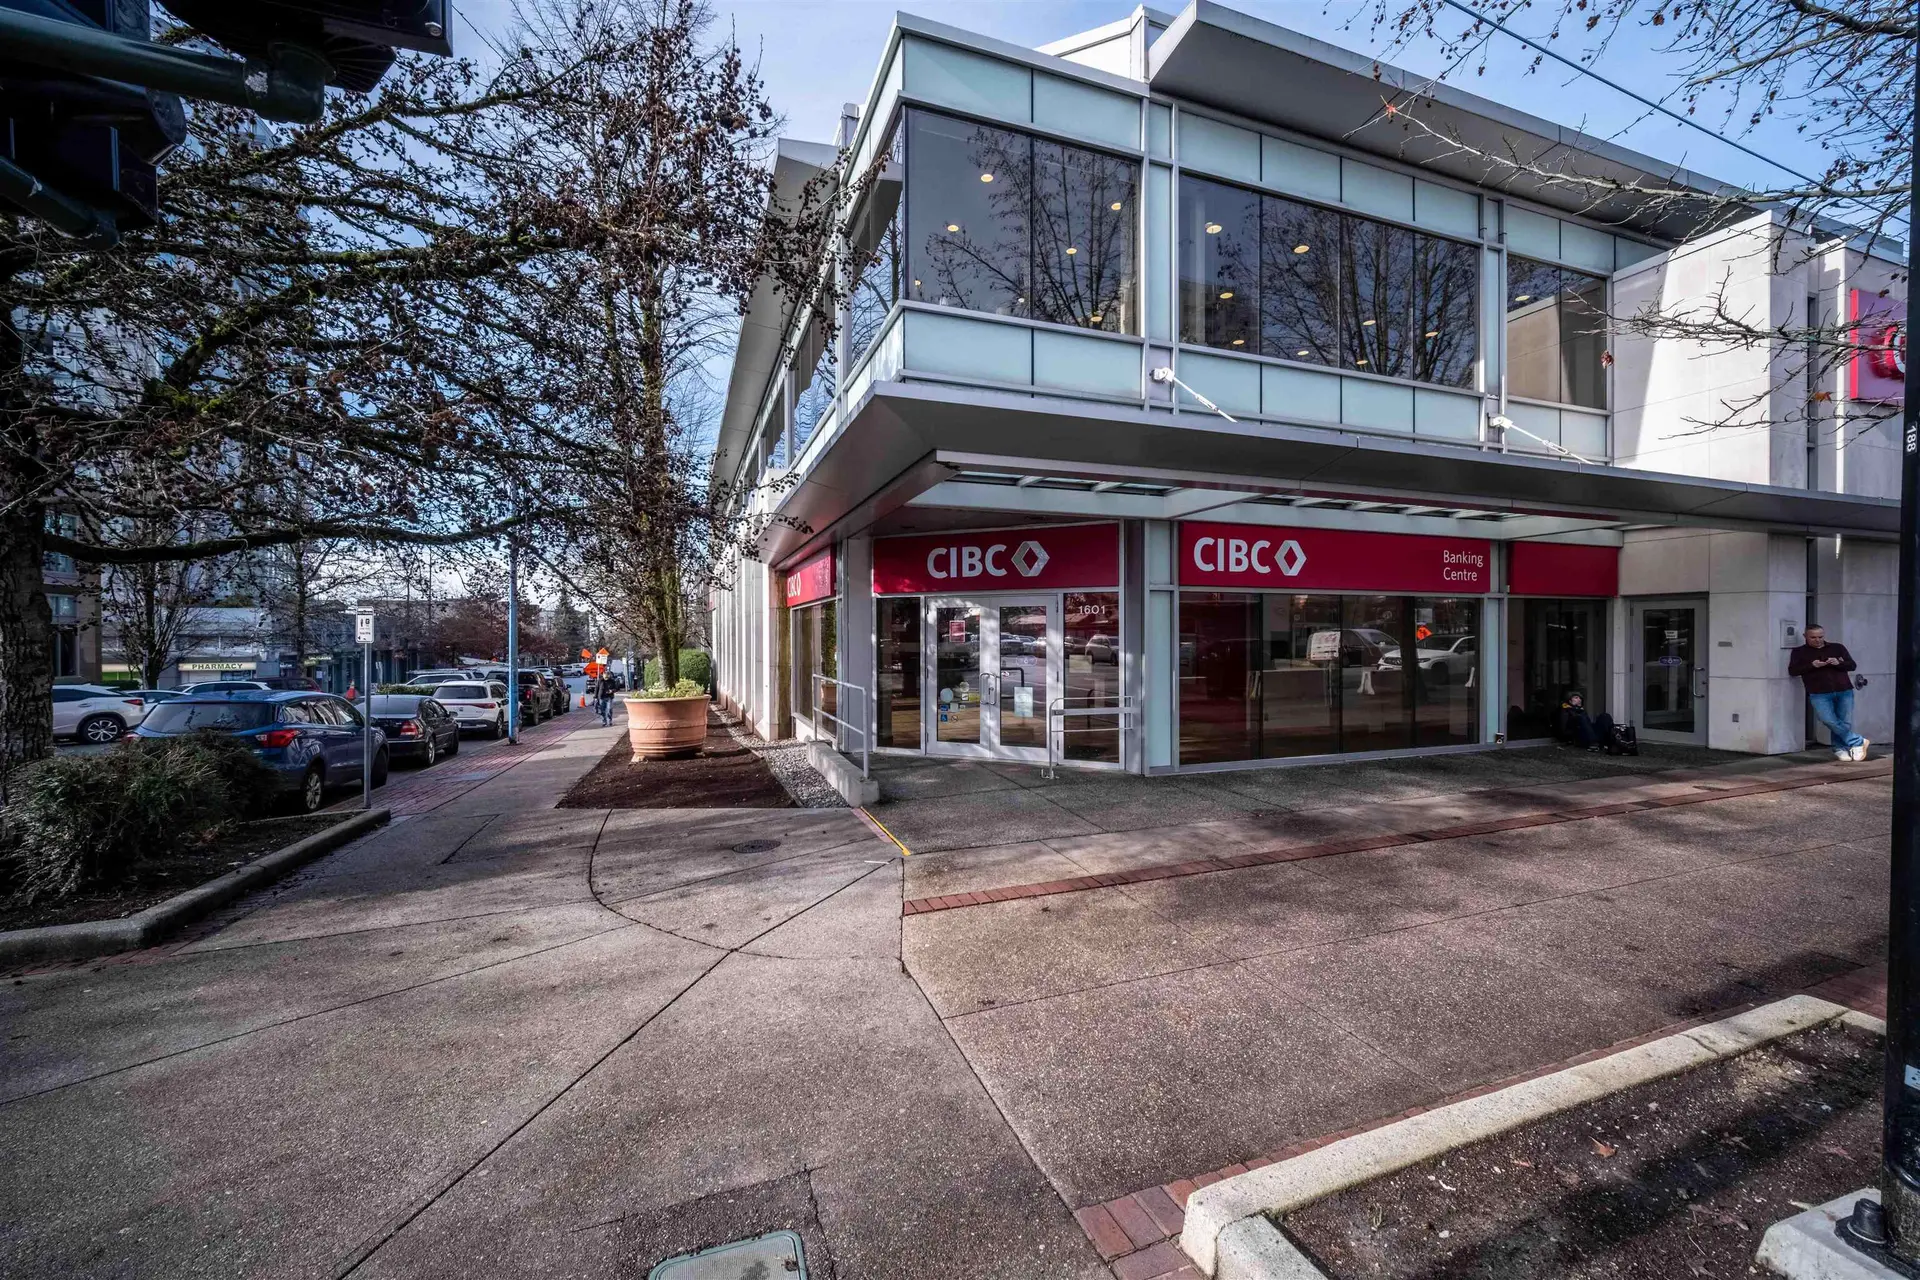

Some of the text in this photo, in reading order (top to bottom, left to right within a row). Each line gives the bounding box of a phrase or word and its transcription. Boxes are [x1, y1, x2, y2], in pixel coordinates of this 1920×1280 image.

[1907, 425, 1917, 453] 188
[927, 544, 1007, 578] CIBC
[1193, 537, 1271, 573] CIBC
[1443, 550, 1483, 567] Banking
[1443, 567, 1478, 581] Centre
[1079, 605, 1106, 614] 1601
